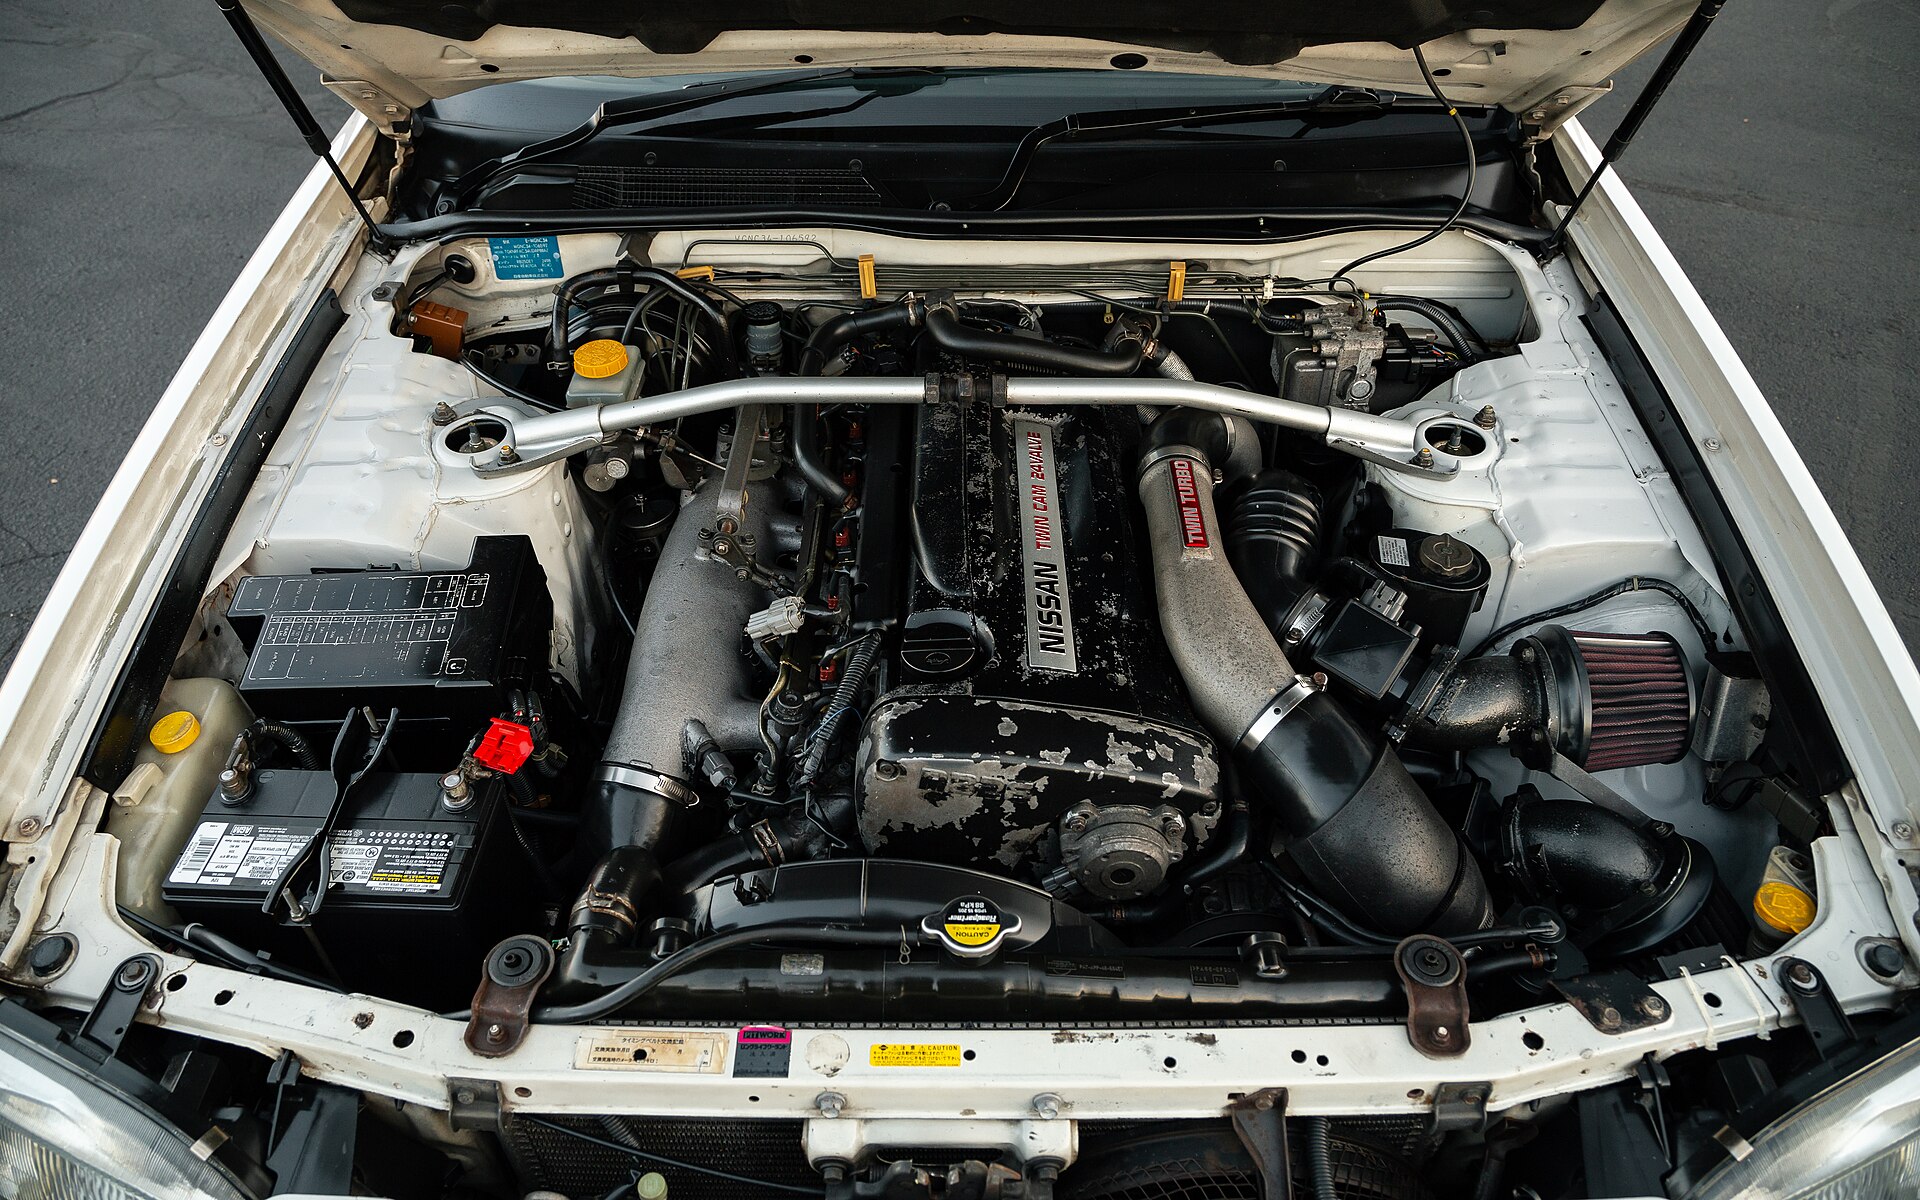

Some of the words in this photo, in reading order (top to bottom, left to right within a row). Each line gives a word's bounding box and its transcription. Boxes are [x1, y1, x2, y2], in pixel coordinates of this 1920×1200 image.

[1027, 431, 1046, 481] 24VALVE
[1032, 484, 1048, 512] CAM
[1173, 460, 1198, 504] TURBO
[1034, 516, 1052, 551] TWIN
[1182, 508, 1204, 544] TWIN
[1033, 561, 1067, 656] NISSAN
[948, 914, 997, 922] Roadpartner
